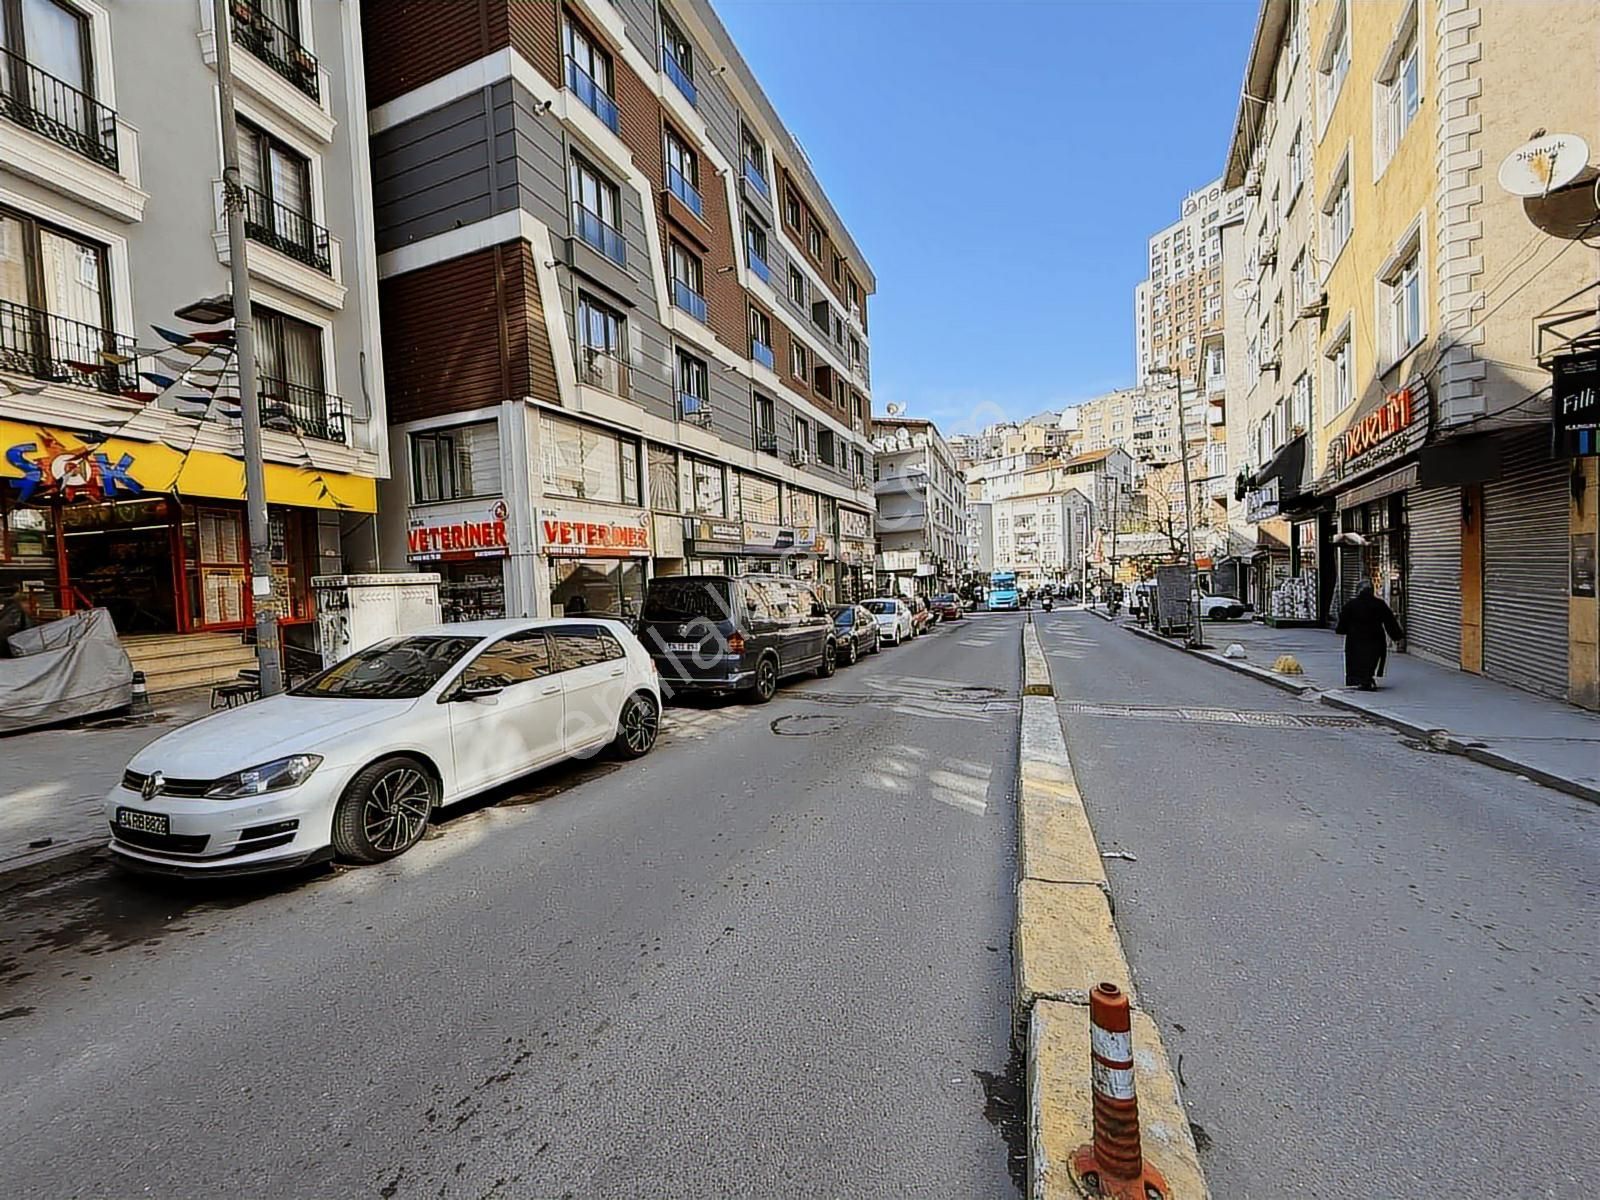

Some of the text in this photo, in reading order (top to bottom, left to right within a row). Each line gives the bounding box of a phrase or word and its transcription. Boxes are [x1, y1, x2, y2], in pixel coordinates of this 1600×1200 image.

[1563, 388, 1596, 415] Filli
[407, 519, 507, 553] VETERİNER
[543, 520, 649, 548] VETERİNER
